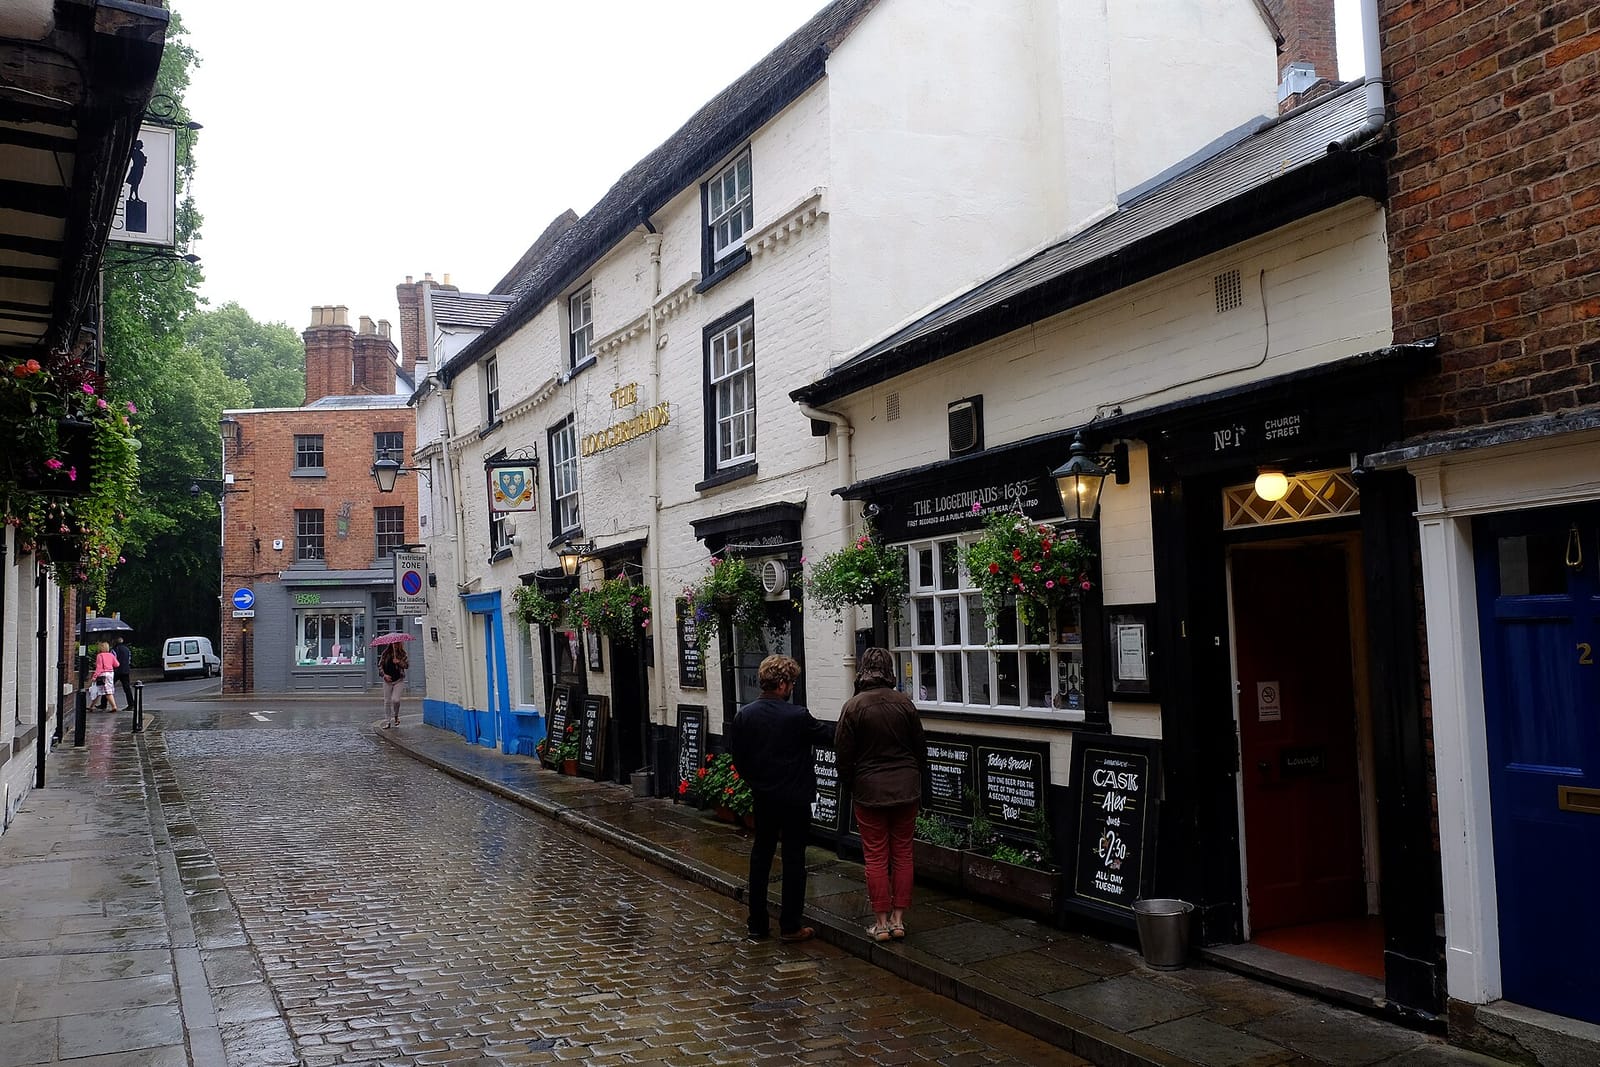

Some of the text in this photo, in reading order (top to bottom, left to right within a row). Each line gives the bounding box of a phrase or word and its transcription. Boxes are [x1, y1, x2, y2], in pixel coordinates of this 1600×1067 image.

[609, 383, 638, 410] THE
[581, 400, 669, 457] LOGGERHEADS
[1264, 415, 1300, 430] CHURCH
[1265, 425, 1300, 440] STREET
[913, 499, 932, 516] THE
[935, 486, 998, 512] LOGGERHEADS
[907, 519, 918, 527] FIRST
[401, 561, 421, 569] ZONE
[1576, 643, 1593, 665] 2
[954, 750, 968, 761] WIFE?
[987, 753, 1007, 770] Today's
[987, 775, 1034, 789] BUY ONE BEER FOR THE
[1092, 768, 1139, 791] CASK
[987, 783, 999, 792] PRICE
[999, 785, 1006, 793] OF
[1006, 786, 1015, 795] TWO
[1019, 789, 1035, 798] RECEIVE
[988, 791, 1035, 807] A SECOND ABSOLUTELY
[1102, 791, 1127, 812] Ales
[1106, 815, 1121, 827] Just
[1095, 870, 1123, 884] ALL DAY
[1095, 879, 1123, 895] TUESDAY
